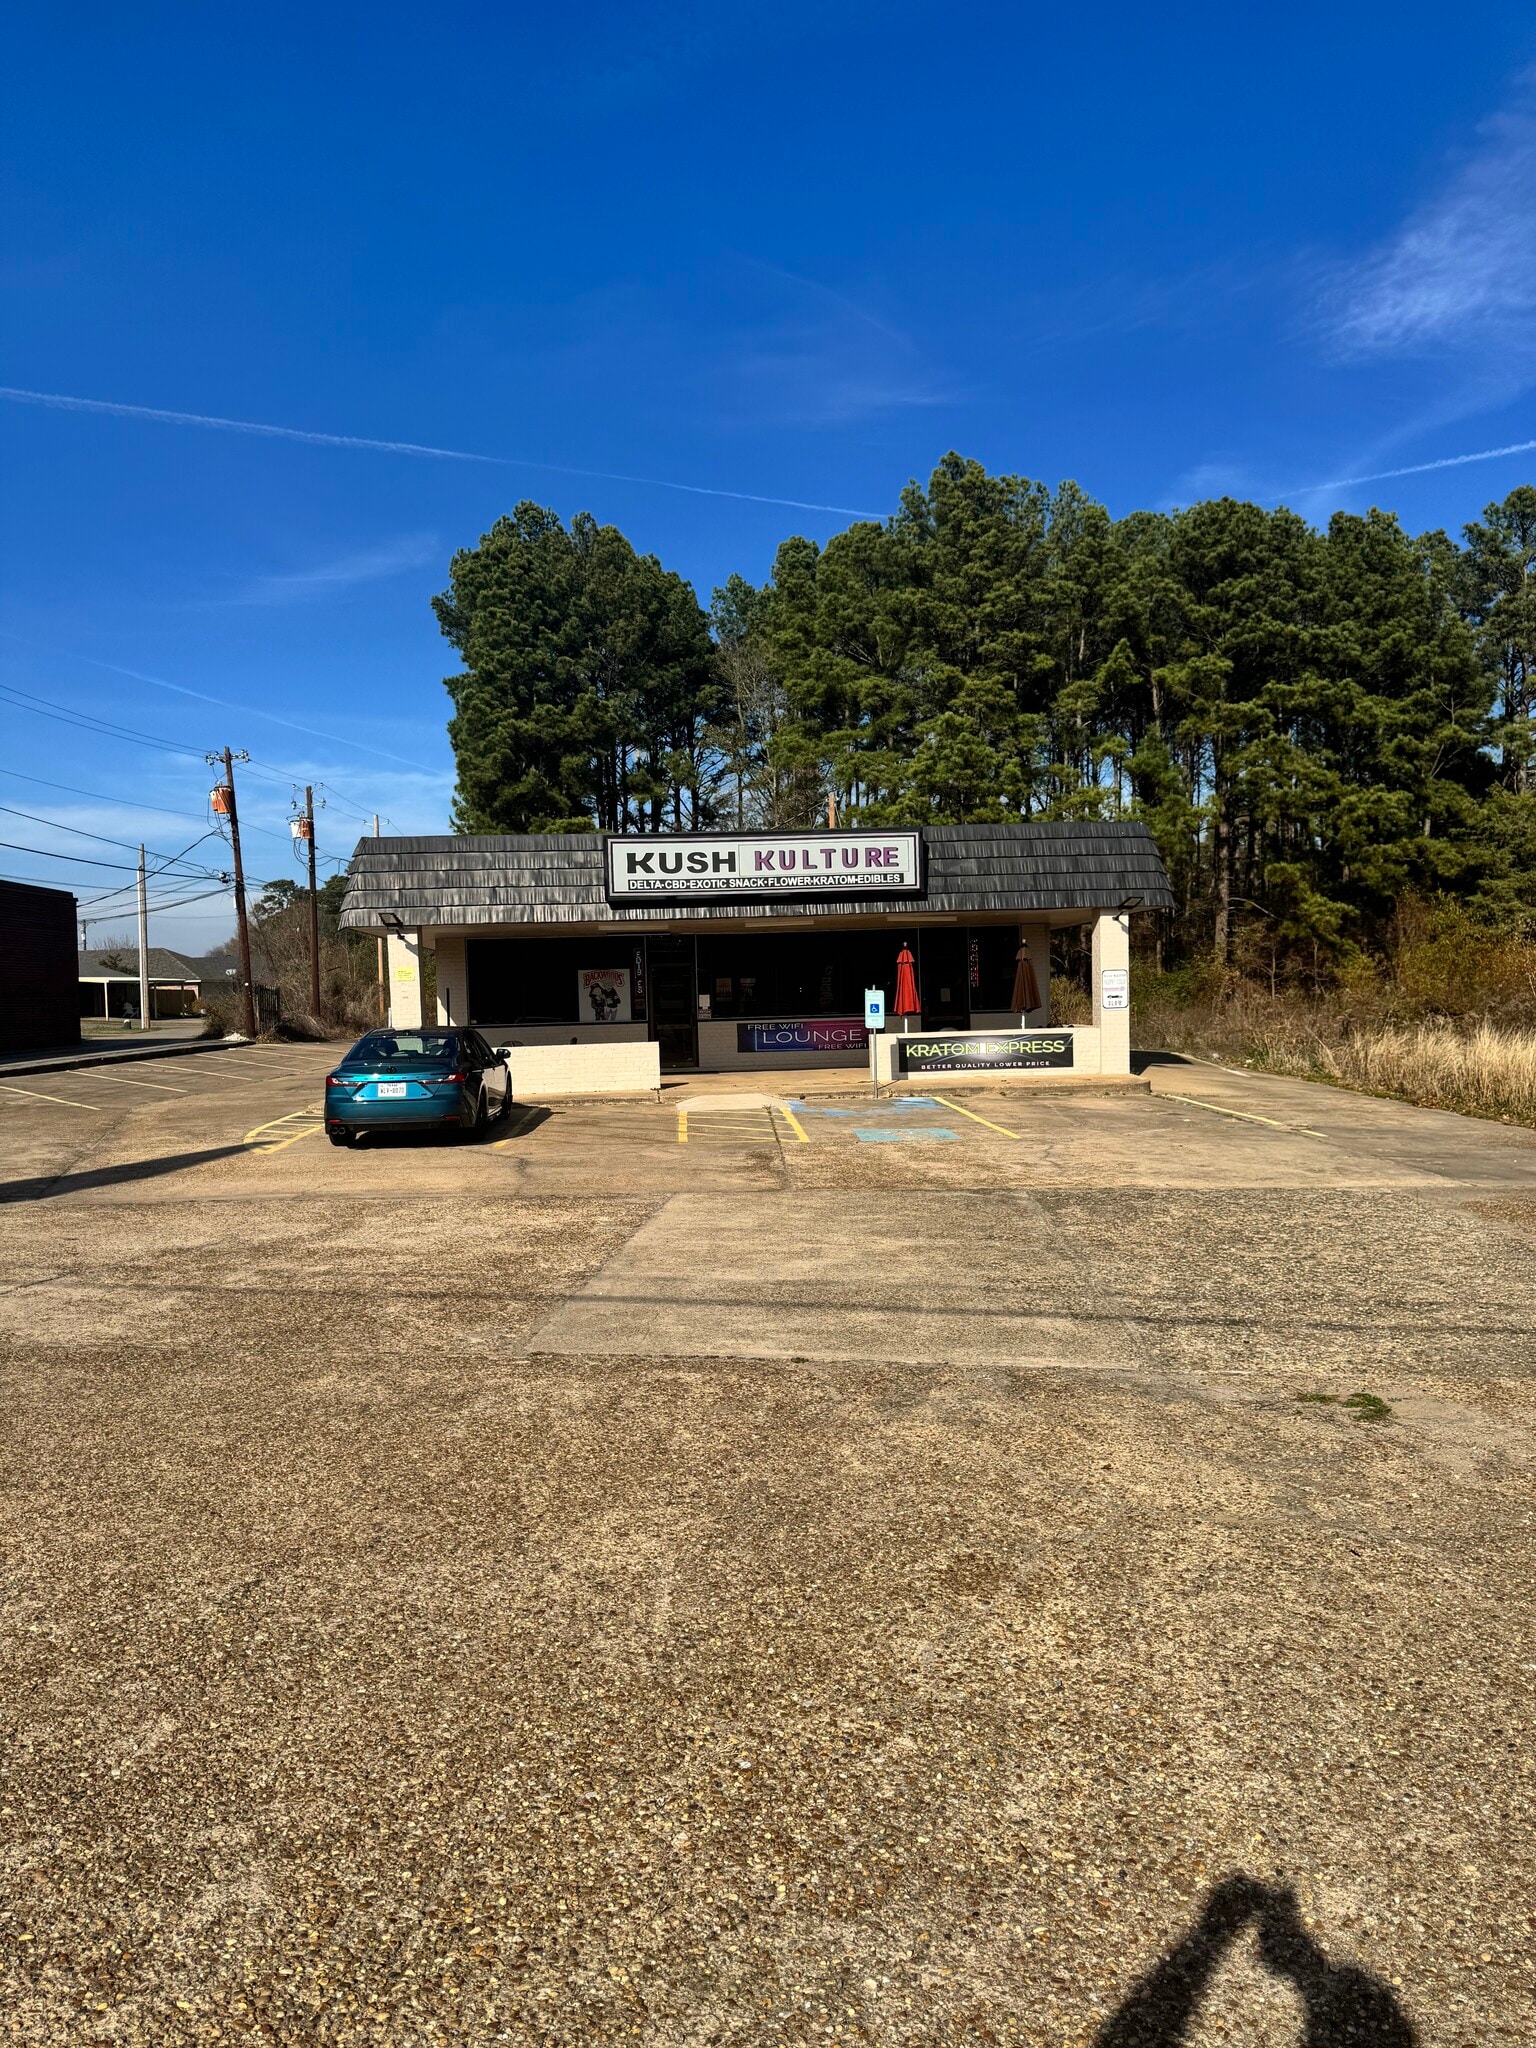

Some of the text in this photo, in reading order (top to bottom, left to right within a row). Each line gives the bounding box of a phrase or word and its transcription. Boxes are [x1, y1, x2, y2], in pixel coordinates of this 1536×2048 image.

[626, 846, 900, 874] KUSH KULTURE
[763, 1029, 863, 1044] LOUNGE
[906, 1040, 1065, 1057] KRATOM EXPRESS
